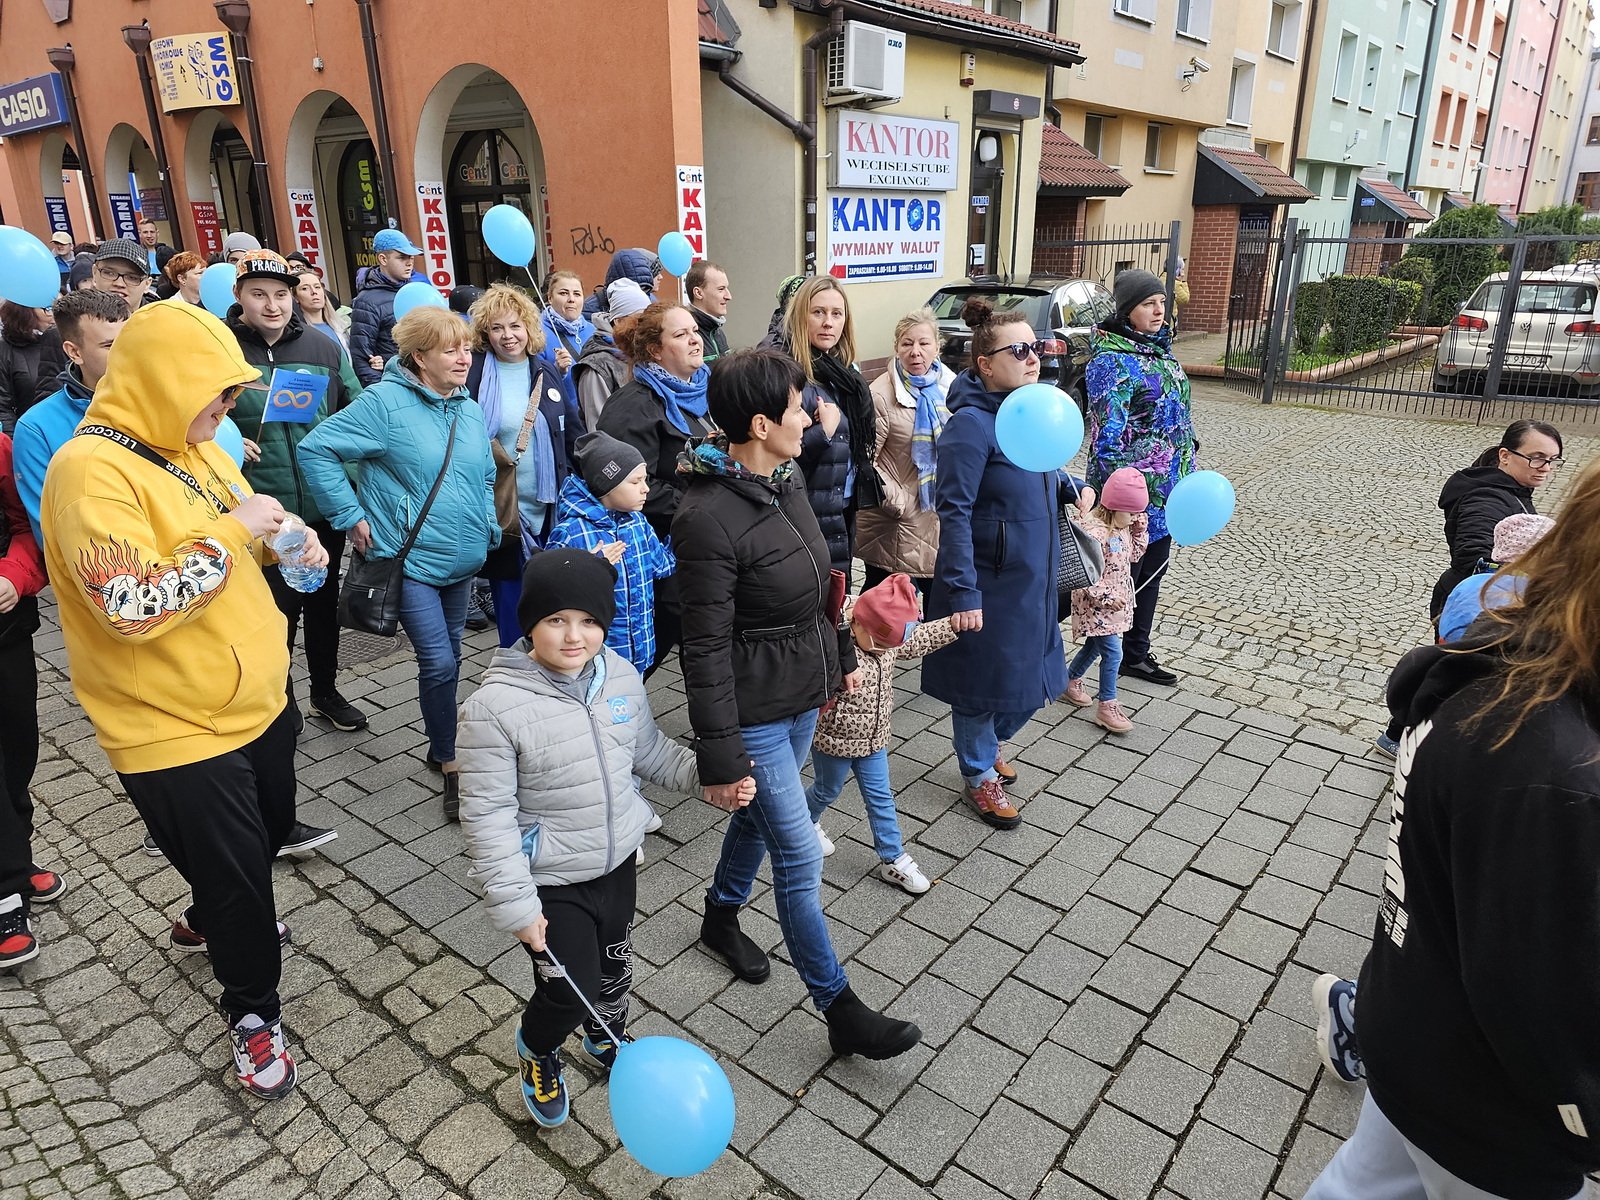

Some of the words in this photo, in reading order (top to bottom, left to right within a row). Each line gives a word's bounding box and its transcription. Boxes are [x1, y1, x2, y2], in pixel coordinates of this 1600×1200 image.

[208, 37, 233, 101] GSM
[0, 86, 47, 127] CASIO
[846, 120, 950, 159] KANTOR
[847, 158, 950, 174] WECHSELSTUBE
[679, 172, 702, 182] Cent
[869, 174, 930, 187] EXCHANGE
[291, 192, 314, 201] Cent
[418, 185, 442, 195] Cent
[832, 197, 940, 231] KANTOR
[683, 188, 703, 264] KAN
[294, 203, 325, 288] KANT
[832, 242, 894, 256] WYMIANY
[900, 241, 940, 254] WALUT
[251, 260, 286, 274] PRAGUE
